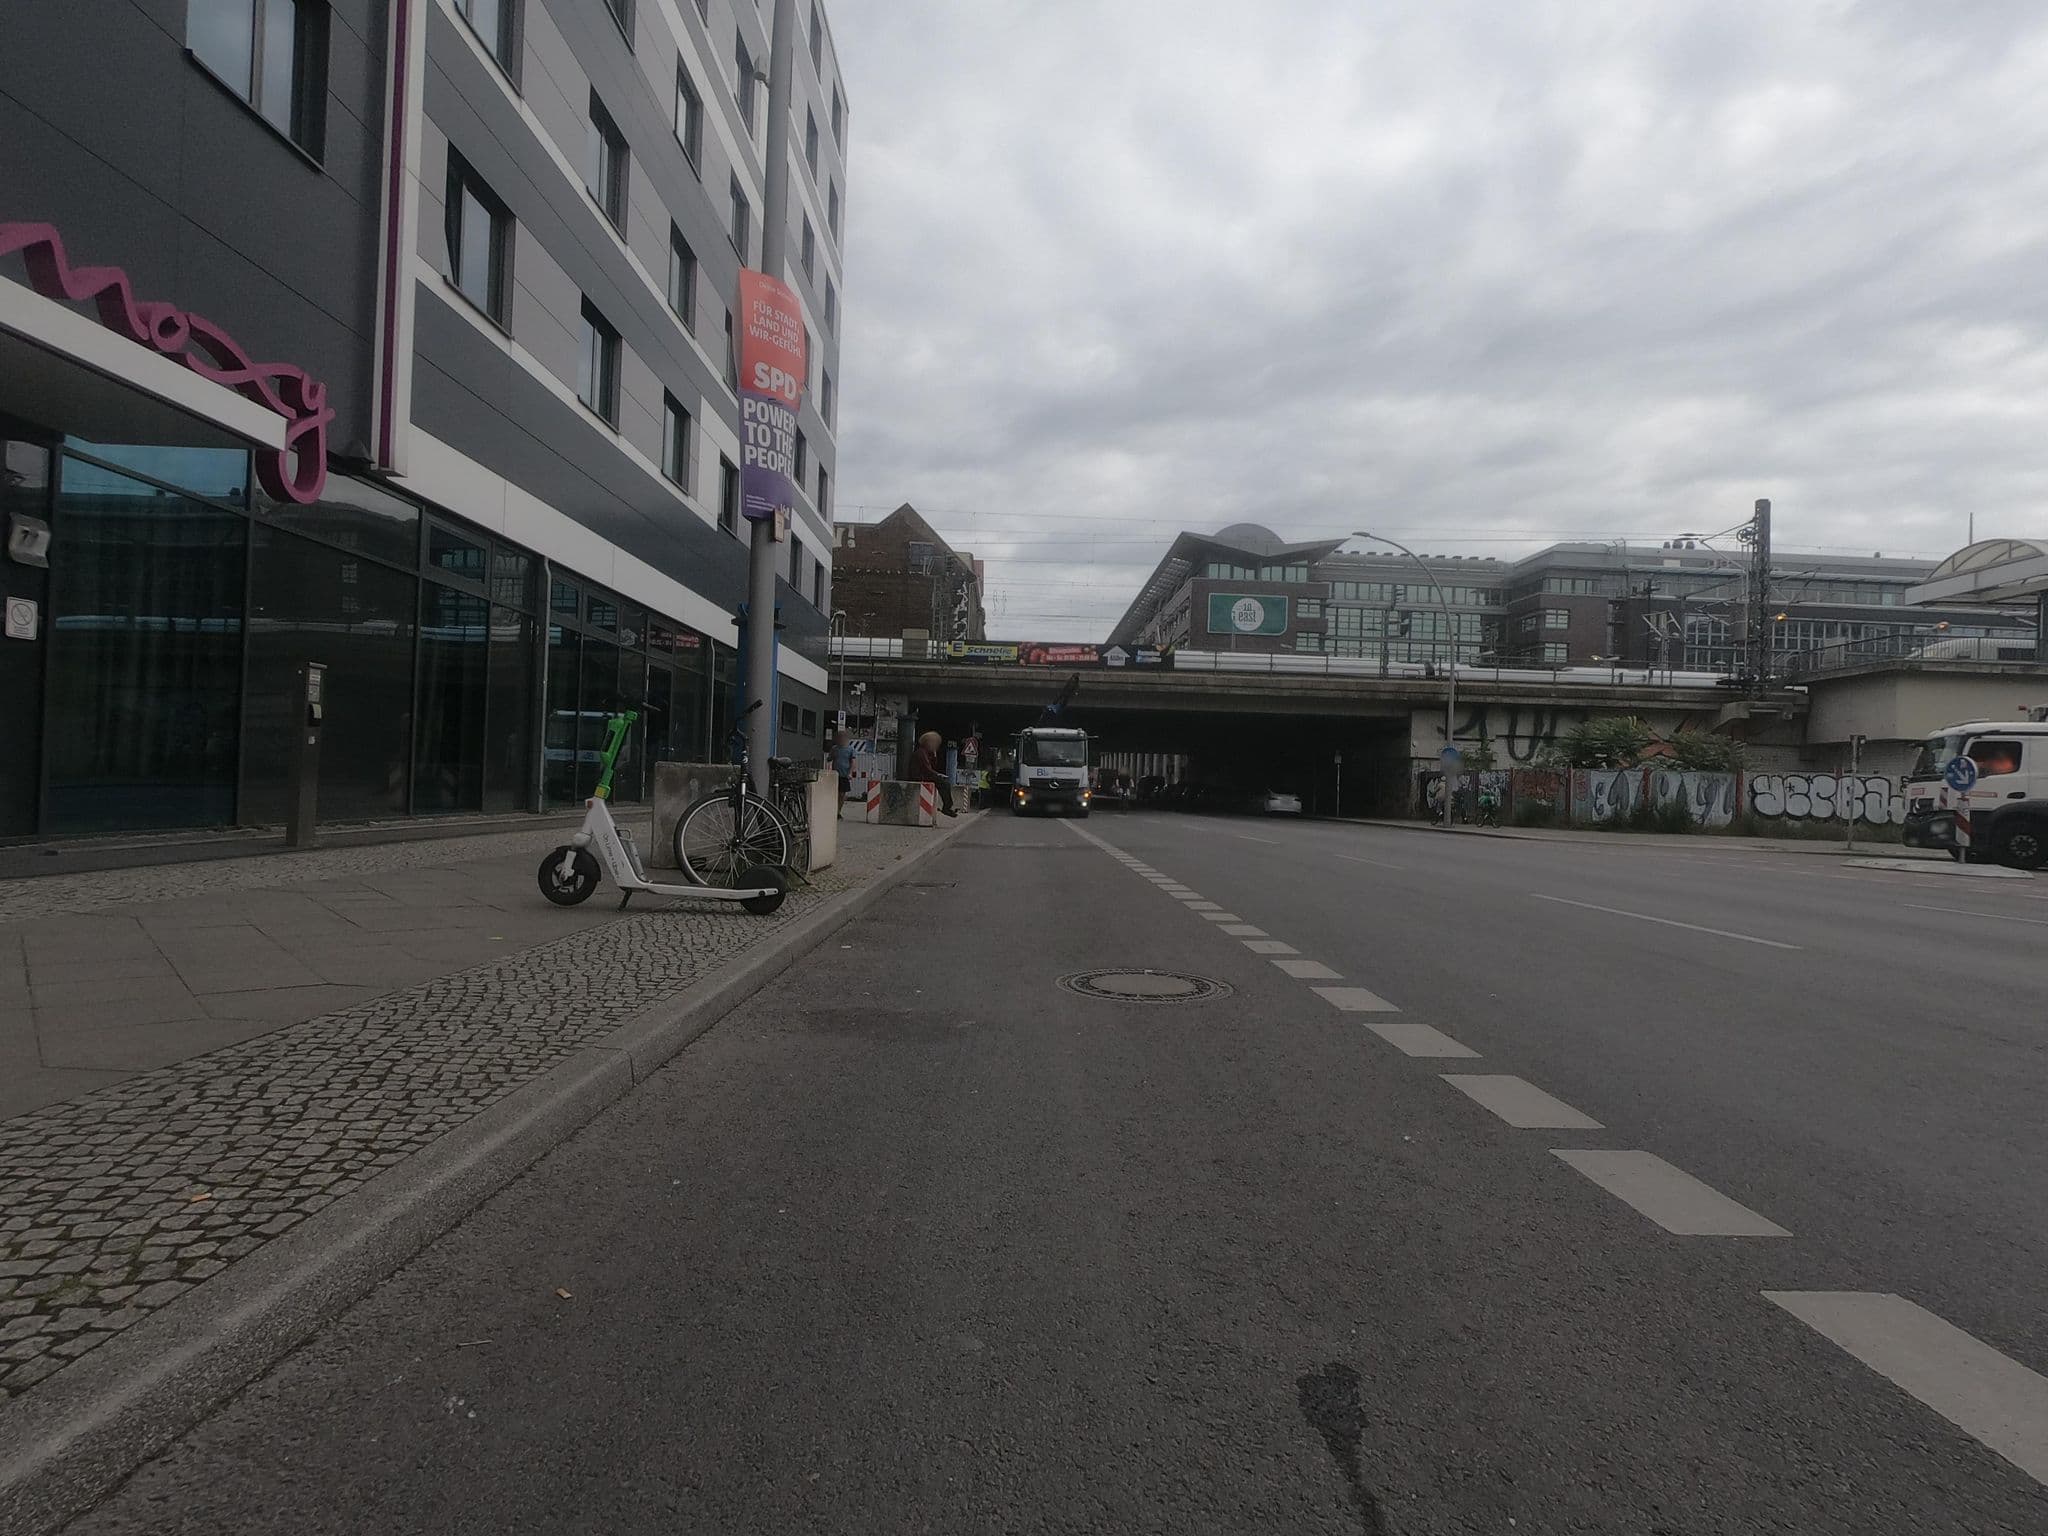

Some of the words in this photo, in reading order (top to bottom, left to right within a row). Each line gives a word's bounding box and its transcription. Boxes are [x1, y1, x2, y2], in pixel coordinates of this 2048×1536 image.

[753, 299, 773, 317] FÜR
[749, 324, 803, 358] WIR-GEFÜHL
[753, 314, 780, 333] LAND
[781, 324, 799, 344] UND
[752, 361, 797, 401] SPD
[743, 397, 796, 436] POWER
[743, 420, 771, 448] TO
[772, 427, 794, 459] THE
